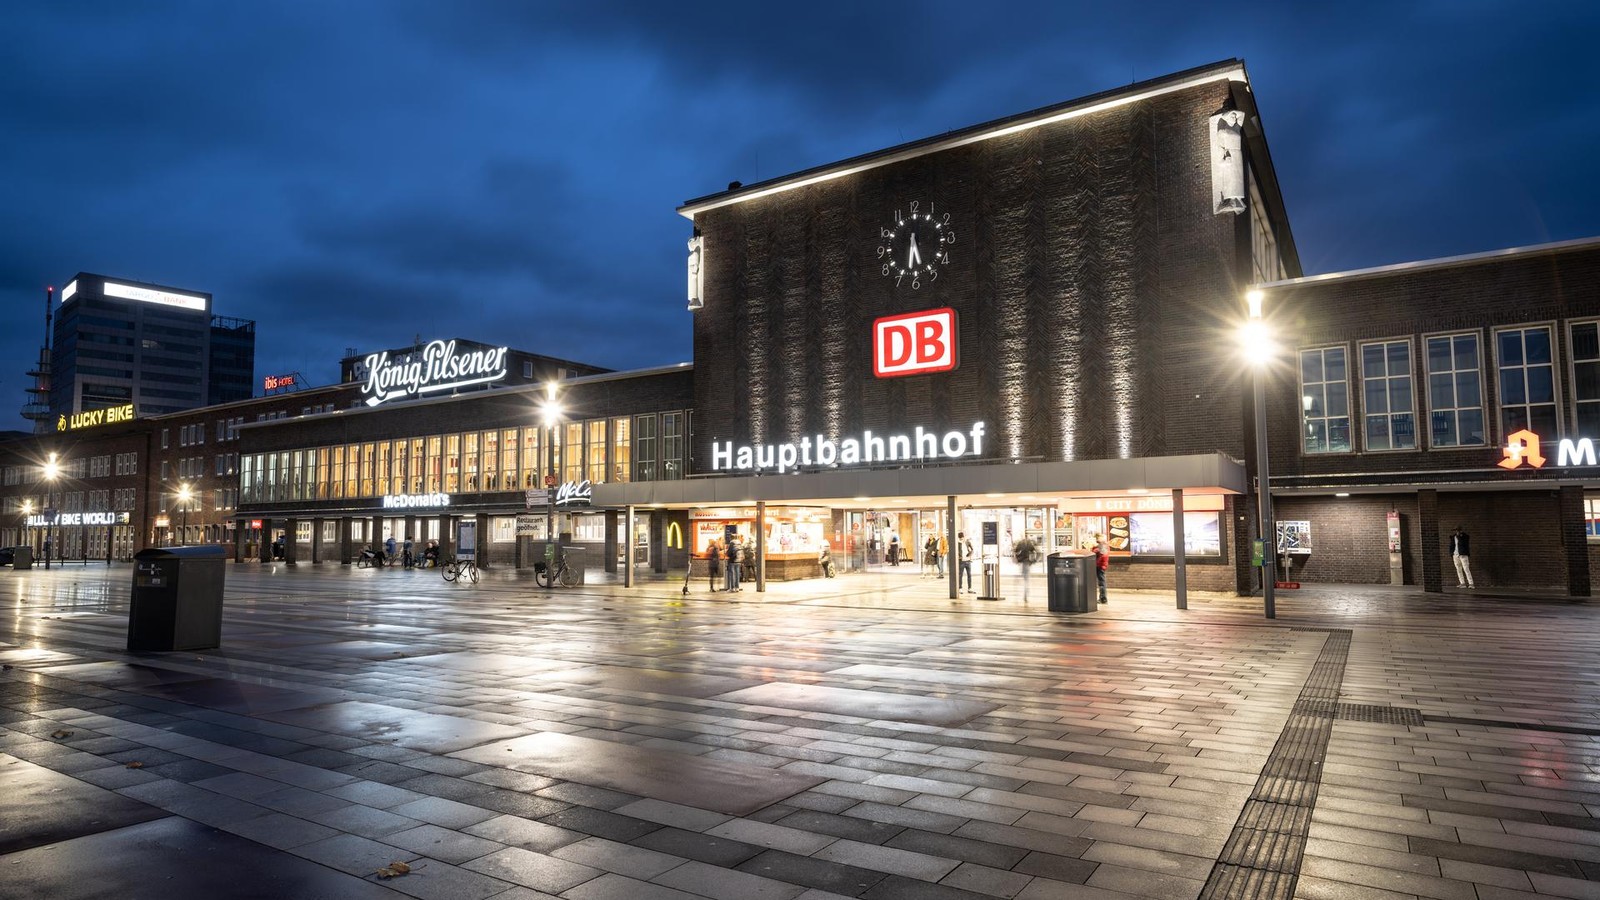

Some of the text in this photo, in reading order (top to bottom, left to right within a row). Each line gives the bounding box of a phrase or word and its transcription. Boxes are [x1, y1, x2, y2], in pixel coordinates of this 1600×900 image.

[909, 201, 919, 213] 12
[894, 210, 902, 222] 11
[942, 213, 951, 226] 2
[880, 226, 890, 238] 10
[947, 231, 956, 244] 3
[877, 246, 885, 259] 9
[941, 252, 950, 265] 4
[882, 264, 890, 276] 8
[930, 269, 938, 282] 5
[894, 275, 903, 287] 7
[912, 276, 920, 290] 6
[883, 319, 945, 368] DB
[361, 351, 422, 397] König
[420, 339, 508, 385] Pilsener
[265, 376, 294, 390] ibis HOTEL
[70, 404, 133, 429] LUCKY BIKE
[712, 421, 985, 474] Hauptbahnhof
[556, 479, 592, 502] McCa
[383, 492, 450, 508] McDonald's
[1105, 496, 1173, 510] CITY DÖNE
[61, 512, 81, 525] BIKE
[82, 511, 115, 525] WORLD
[516, 516, 544, 524] Restaurant
